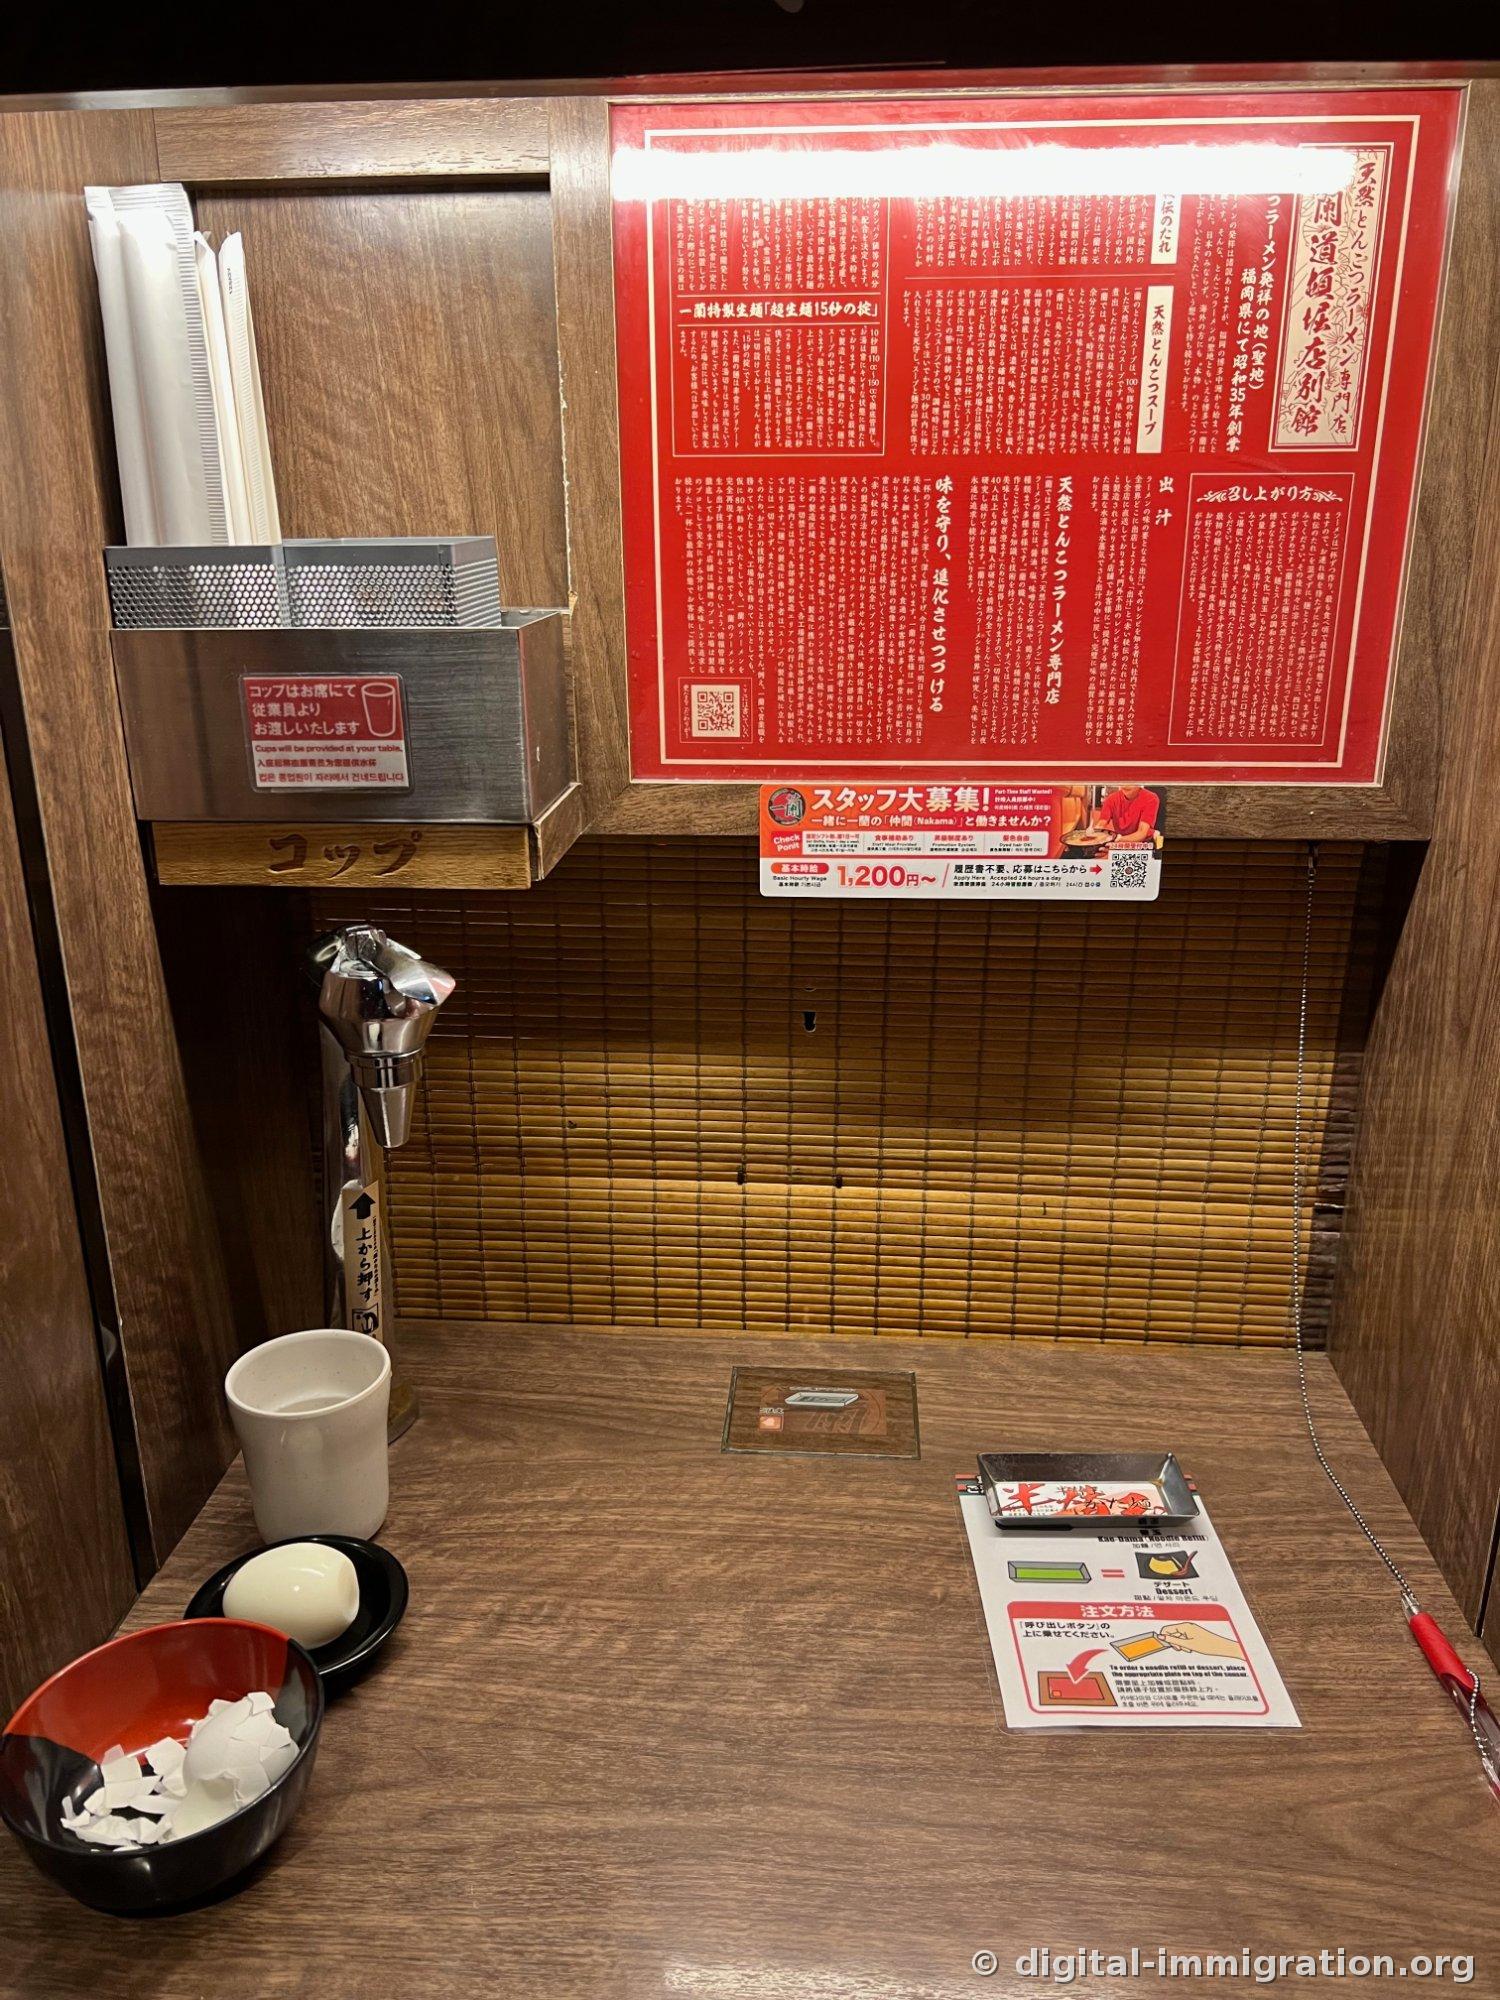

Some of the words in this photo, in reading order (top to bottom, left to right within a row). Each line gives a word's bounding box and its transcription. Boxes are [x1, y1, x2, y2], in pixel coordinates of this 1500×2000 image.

[1328, 161, 1379, 433] 天然とんこつラーメン専門店
[679, 300, 877, 318] 一蘭特製生麺「超生麺15秒の掟」
[1224, 267, 1258, 452] 福岡県にて昭和35年創業
[1143, 304, 1166, 435] 天然とんこつスープ
[1154, 475, 1175, 526] 出汁
[1226, 485, 1315, 501] 召し上がり方
[928, 475, 954, 712] 味を守り、進化させつづける
[1044, 475, 1074, 704] 天然とんこつラーメン専門店
[250, 682, 357, 698] コップはお席にて
[252, 702, 321, 717] 従業員より
[254, 721, 360, 736] お渡しいたします
[306, 745, 344, 753] provided
[811, 786, 990, 813] スタッフ大募集！
[774, 834, 801, 845] Check
[268, 830, 423, 878] コップ
[781, 864, 818, 873] 基本時給
[953, 864, 1088, 874] 履歴書不要、応募はこちらから
[355, 1227, 374, 1302] 上から押す
[1156, 1587, 1193, 1595] Dessert
[1080, 1605, 1155, 1617] 注文方法
[1019, 1621, 1110, 1630] 「呼び出しボタン」の
[1023, 1630, 1114, 1639] 上に乗せてください。
